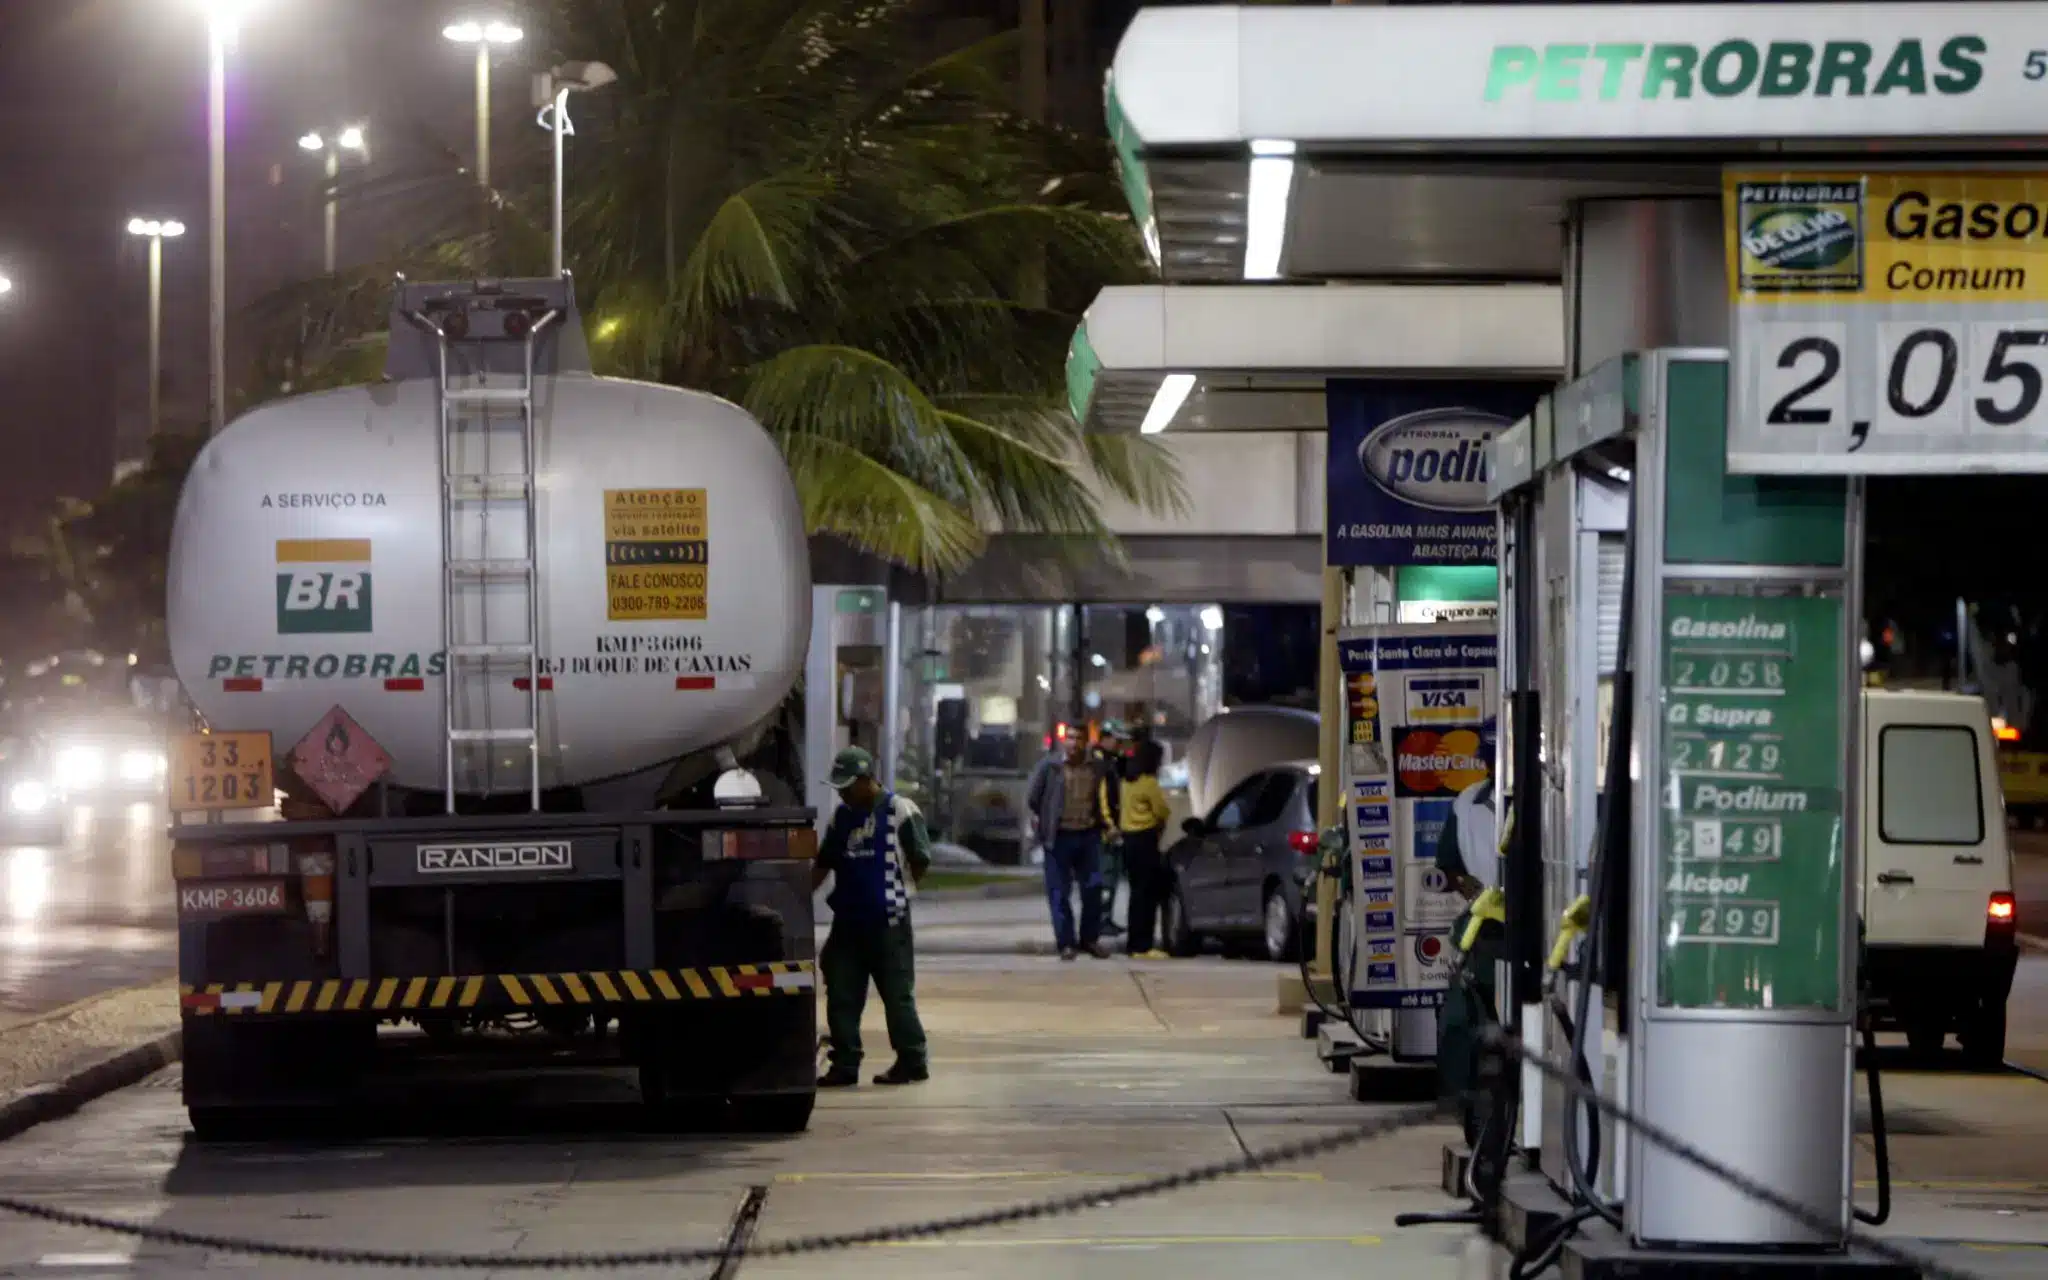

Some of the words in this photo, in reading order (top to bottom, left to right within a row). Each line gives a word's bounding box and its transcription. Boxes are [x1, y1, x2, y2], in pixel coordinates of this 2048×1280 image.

[1483, 35, 1988, 102] PETROBRAS
[1886, 260, 2026, 290] Comum
[261, 494, 273, 509] A
[278, 492, 357, 511] SERVIÇO
[362, 492, 387, 507] DA
[612, 523, 636, 537] via
[1337, 524, 1347, 538] A
[1350, 523, 1413, 539] GASOLINA
[1416, 524, 1449, 539] MAIS
[283, 571, 364, 611] BR
[611, 573, 640, 589] FALE
[643, 572, 704, 589] CONOSCO
[1670, 613, 1787, 640] Gasolina
[1412, 646, 1441, 659] Clara
[207, 651, 448, 679] PETROBRAS
[572, 656, 639, 677] DUQUE
[645, 655, 670, 674] DE
[674, 653, 753, 674] CAXIAS
[1422, 691, 1467, 707] VISA
[1668, 702, 1689, 724] G
[1695, 702, 1773, 728] Supra
[201, 739, 239, 768] 33
[1398, 752, 1488, 772] MasterCard
[184, 773, 260, 802] 1203
[1693, 783, 1808, 812] Podium
[425, 845, 564, 868] RANDON
[232, 885, 281, 907] 3606
